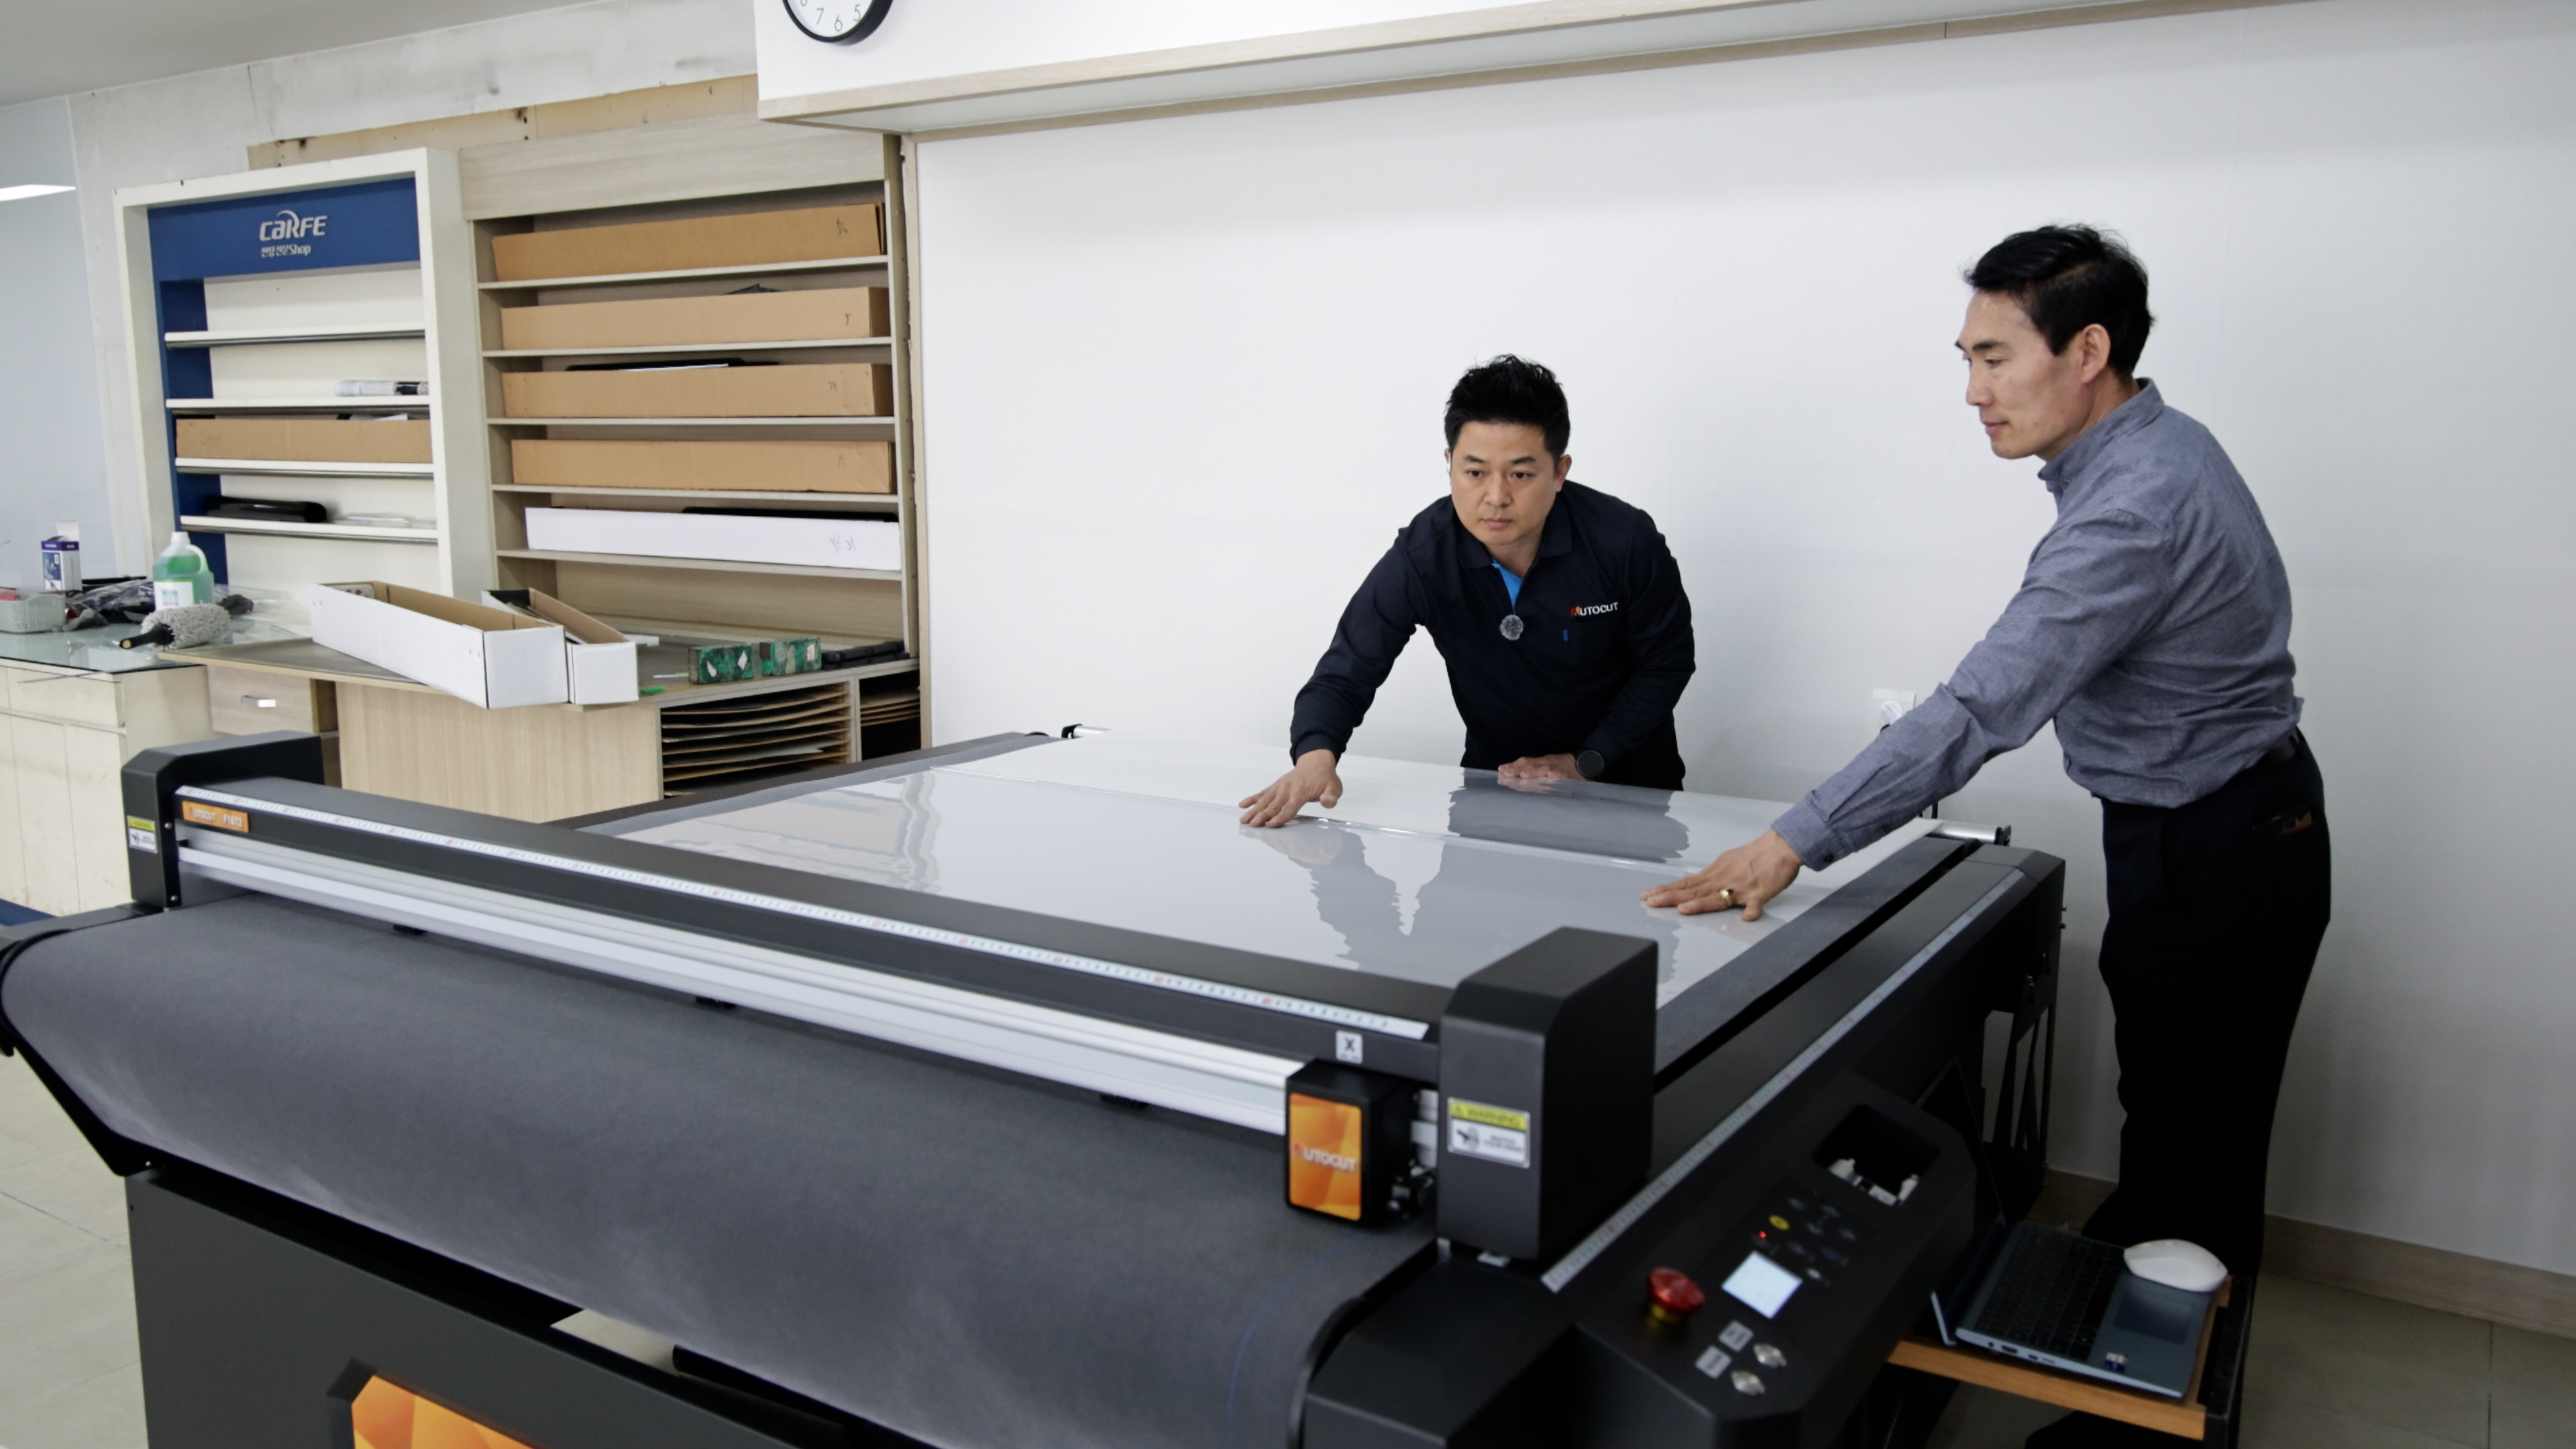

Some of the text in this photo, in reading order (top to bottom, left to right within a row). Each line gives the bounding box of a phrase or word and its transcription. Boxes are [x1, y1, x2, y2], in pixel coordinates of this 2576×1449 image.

[816, 7, 824, 25] 7
[853, 4, 861, 22] 5
[835, 14, 843, 32] 6
